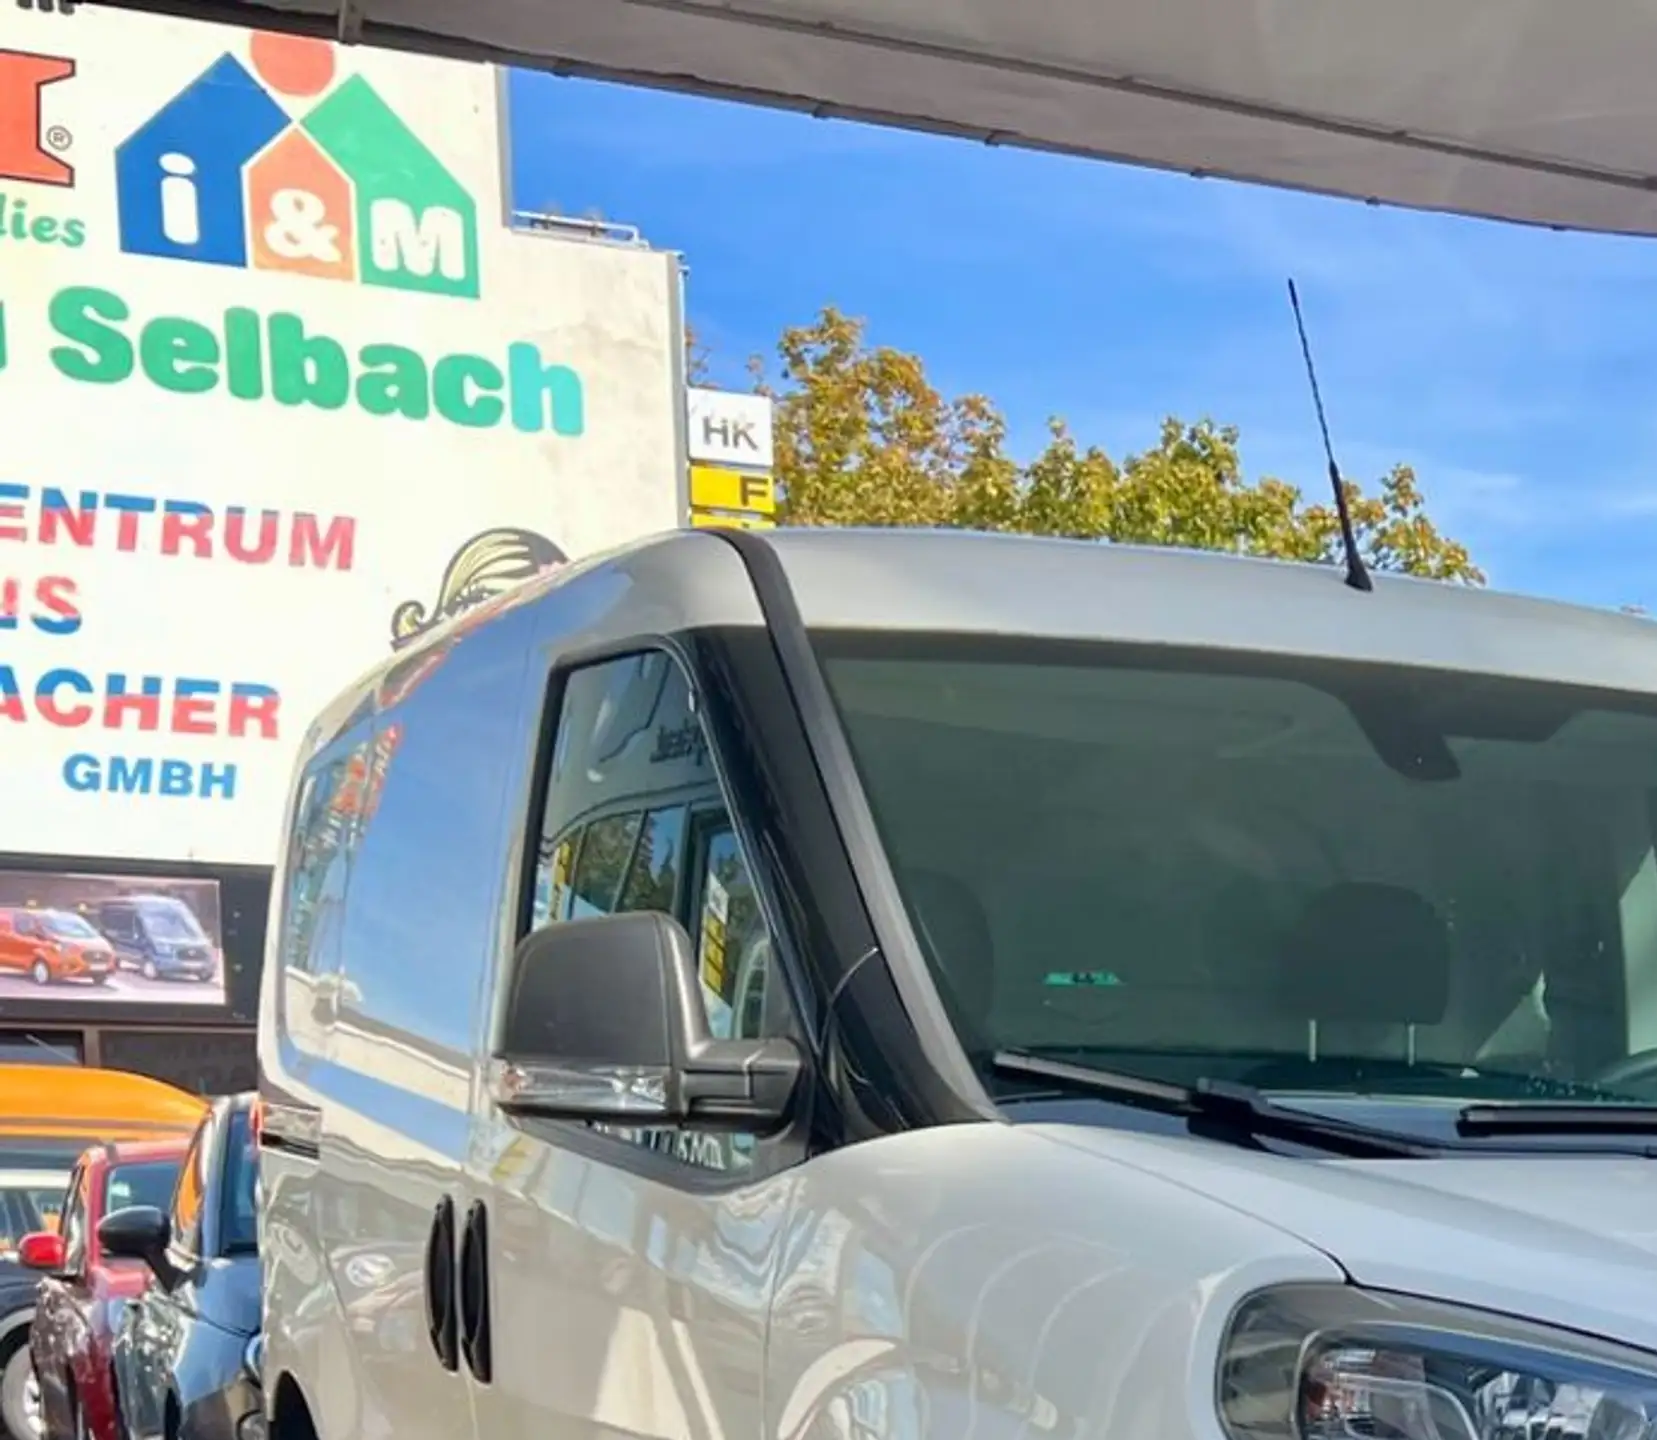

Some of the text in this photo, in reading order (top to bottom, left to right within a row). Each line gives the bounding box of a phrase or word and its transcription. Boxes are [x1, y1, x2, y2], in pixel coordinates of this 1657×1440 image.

[48, 286, 585, 437] Selbach
[703, 415, 759, 451] HK
[0, 483, 357, 571] ENTRUM
[63, 753, 237, 799] GMBH
